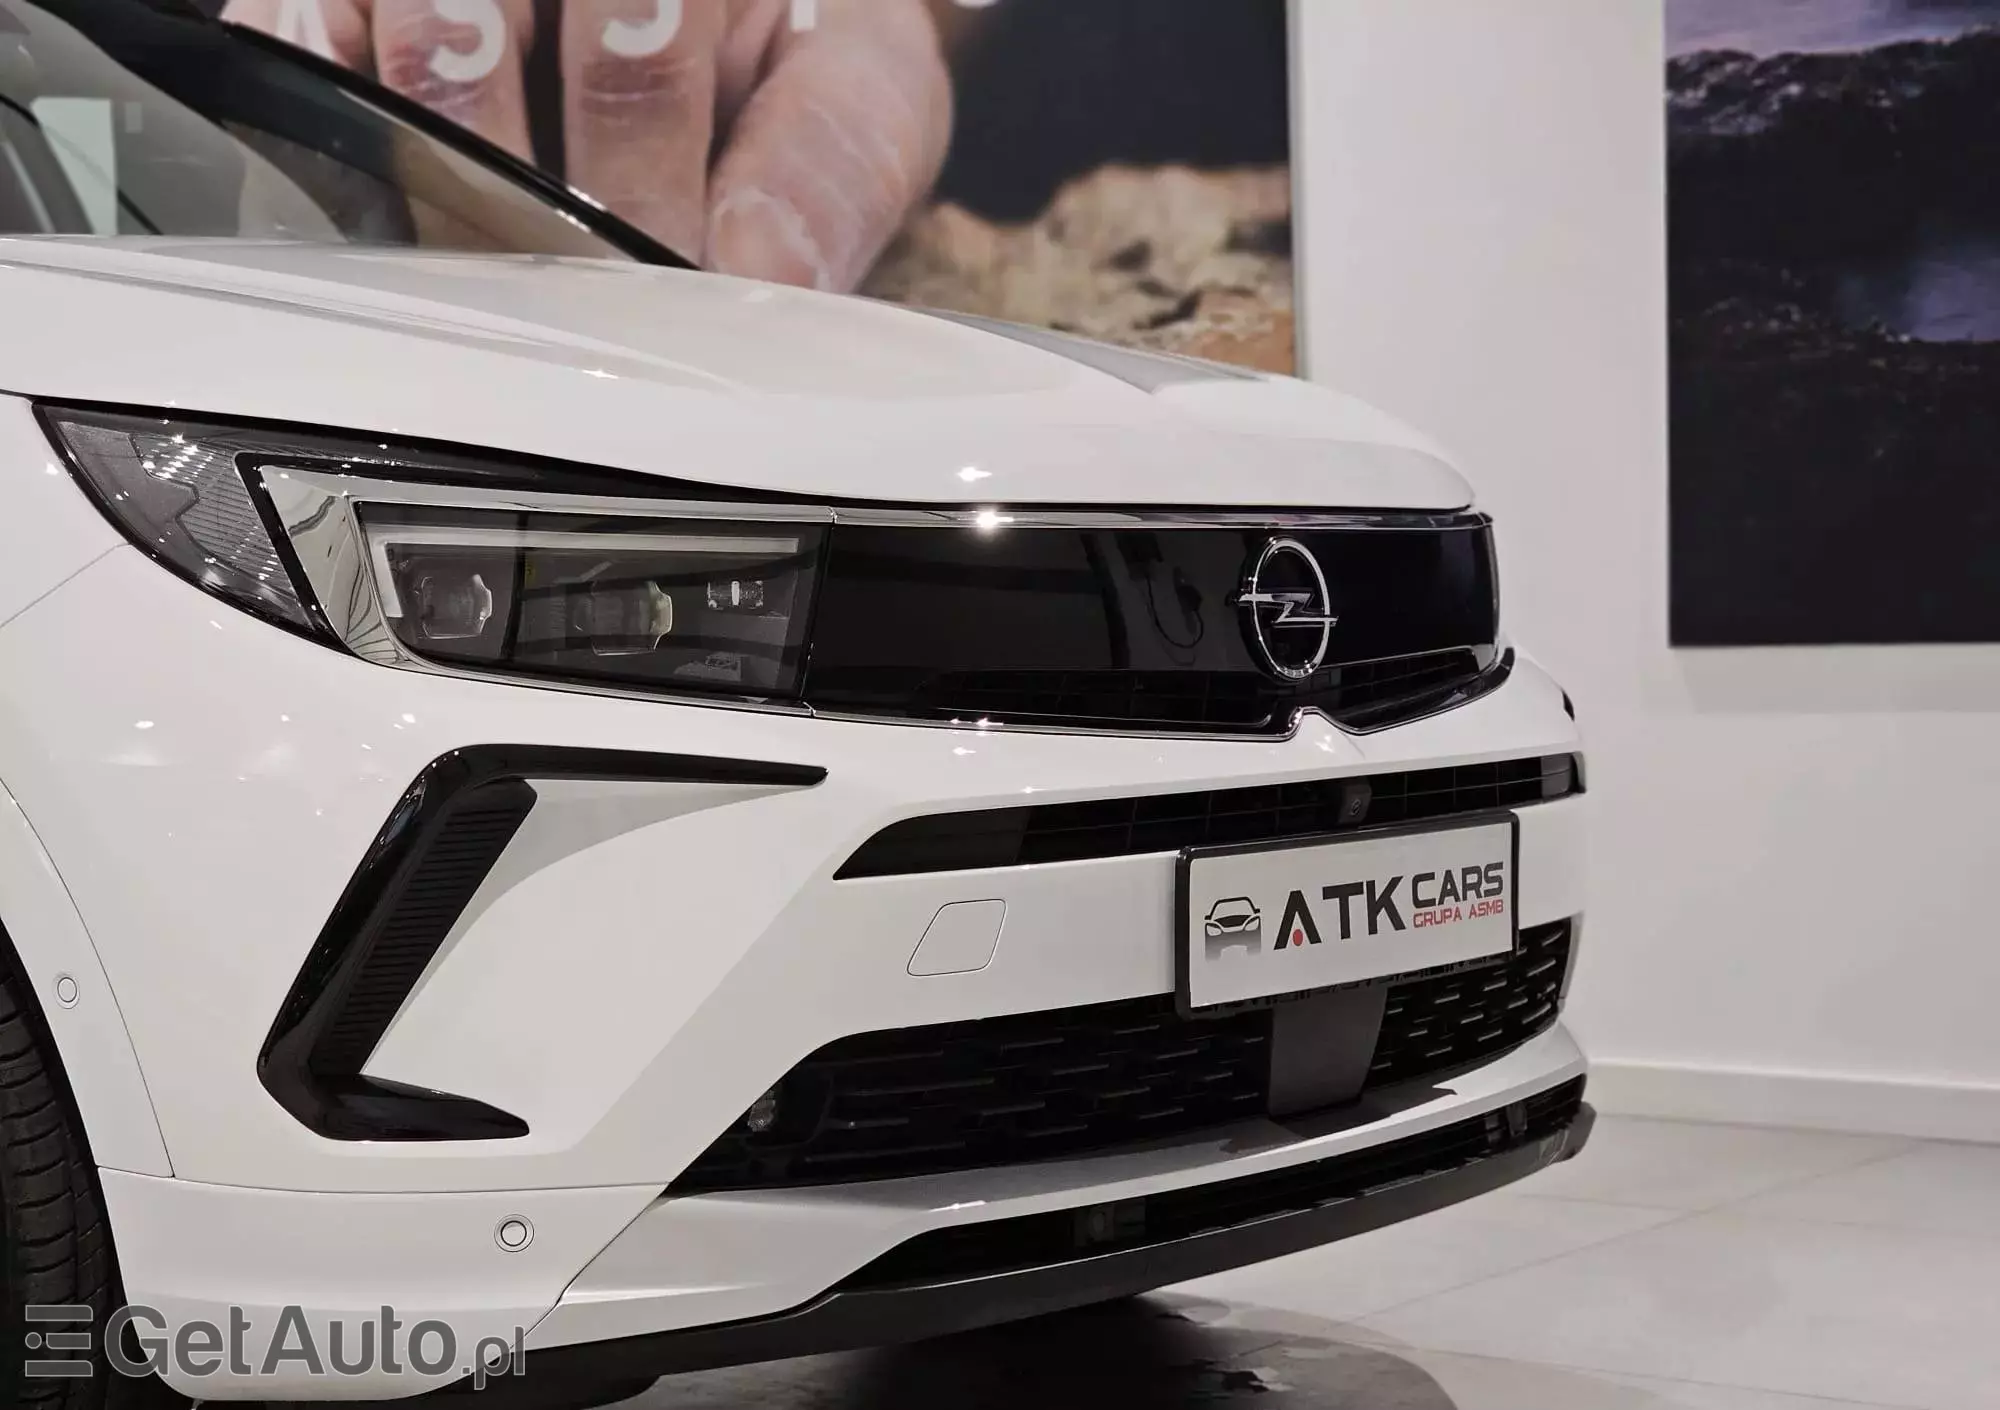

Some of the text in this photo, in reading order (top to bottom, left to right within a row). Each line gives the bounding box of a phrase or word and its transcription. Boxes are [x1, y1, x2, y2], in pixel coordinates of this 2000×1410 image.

[1273, 861, 1504, 950] ATK CARS
[1413, 899, 1504, 928] GRUPA ASMB
